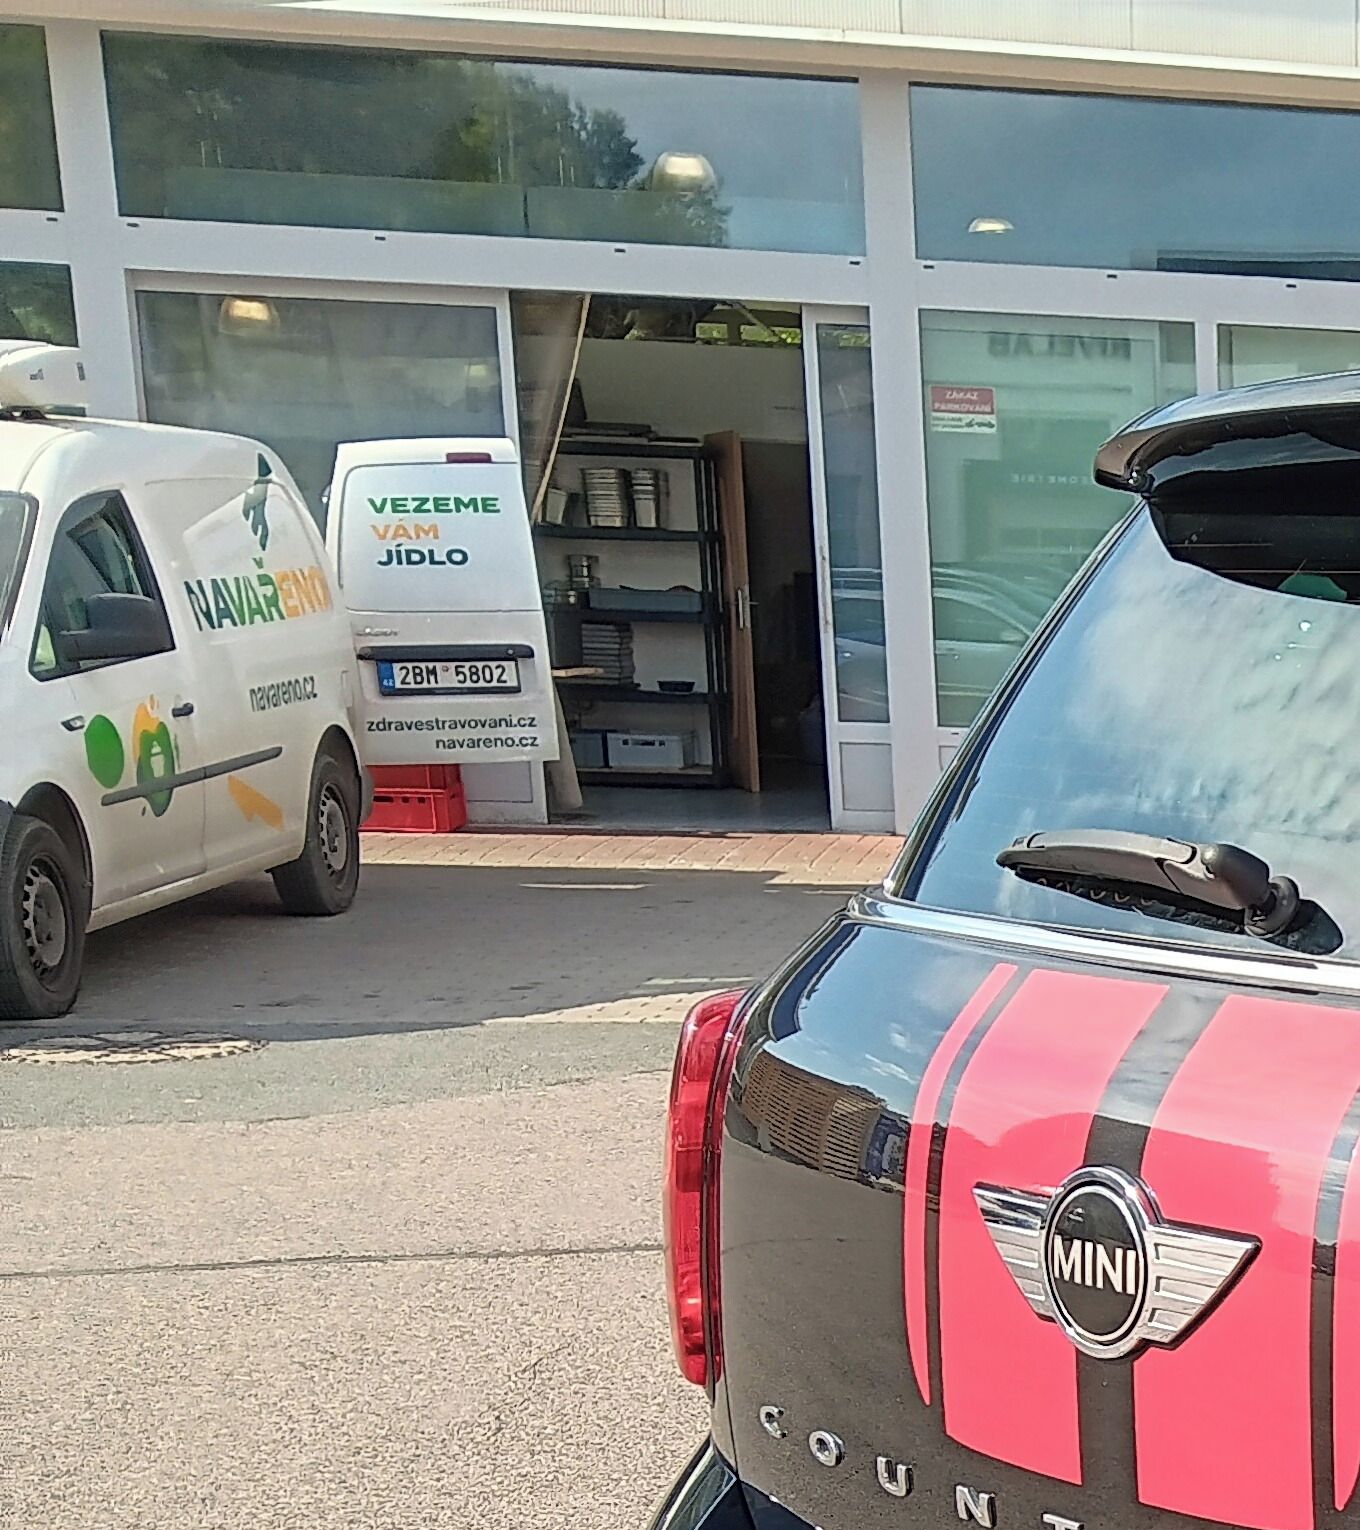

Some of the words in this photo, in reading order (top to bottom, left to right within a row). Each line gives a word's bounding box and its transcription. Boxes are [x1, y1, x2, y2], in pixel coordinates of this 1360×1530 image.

[367, 496, 502, 514] VEZEME
[370, 518, 440, 541] VÁM
[376, 543, 470, 567] JÍDLO
[183, 556, 334, 632] NAVAŘENO
[399, 664, 440, 686] 2BM
[454, 663, 509, 685] 5802
[249, 675, 318, 713] navareno.cz
[366, 713, 538, 732] zdravestravovani.cz
[434, 735, 540, 750] navareno.cz
[1051, 1233, 1140, 1298] MINI
